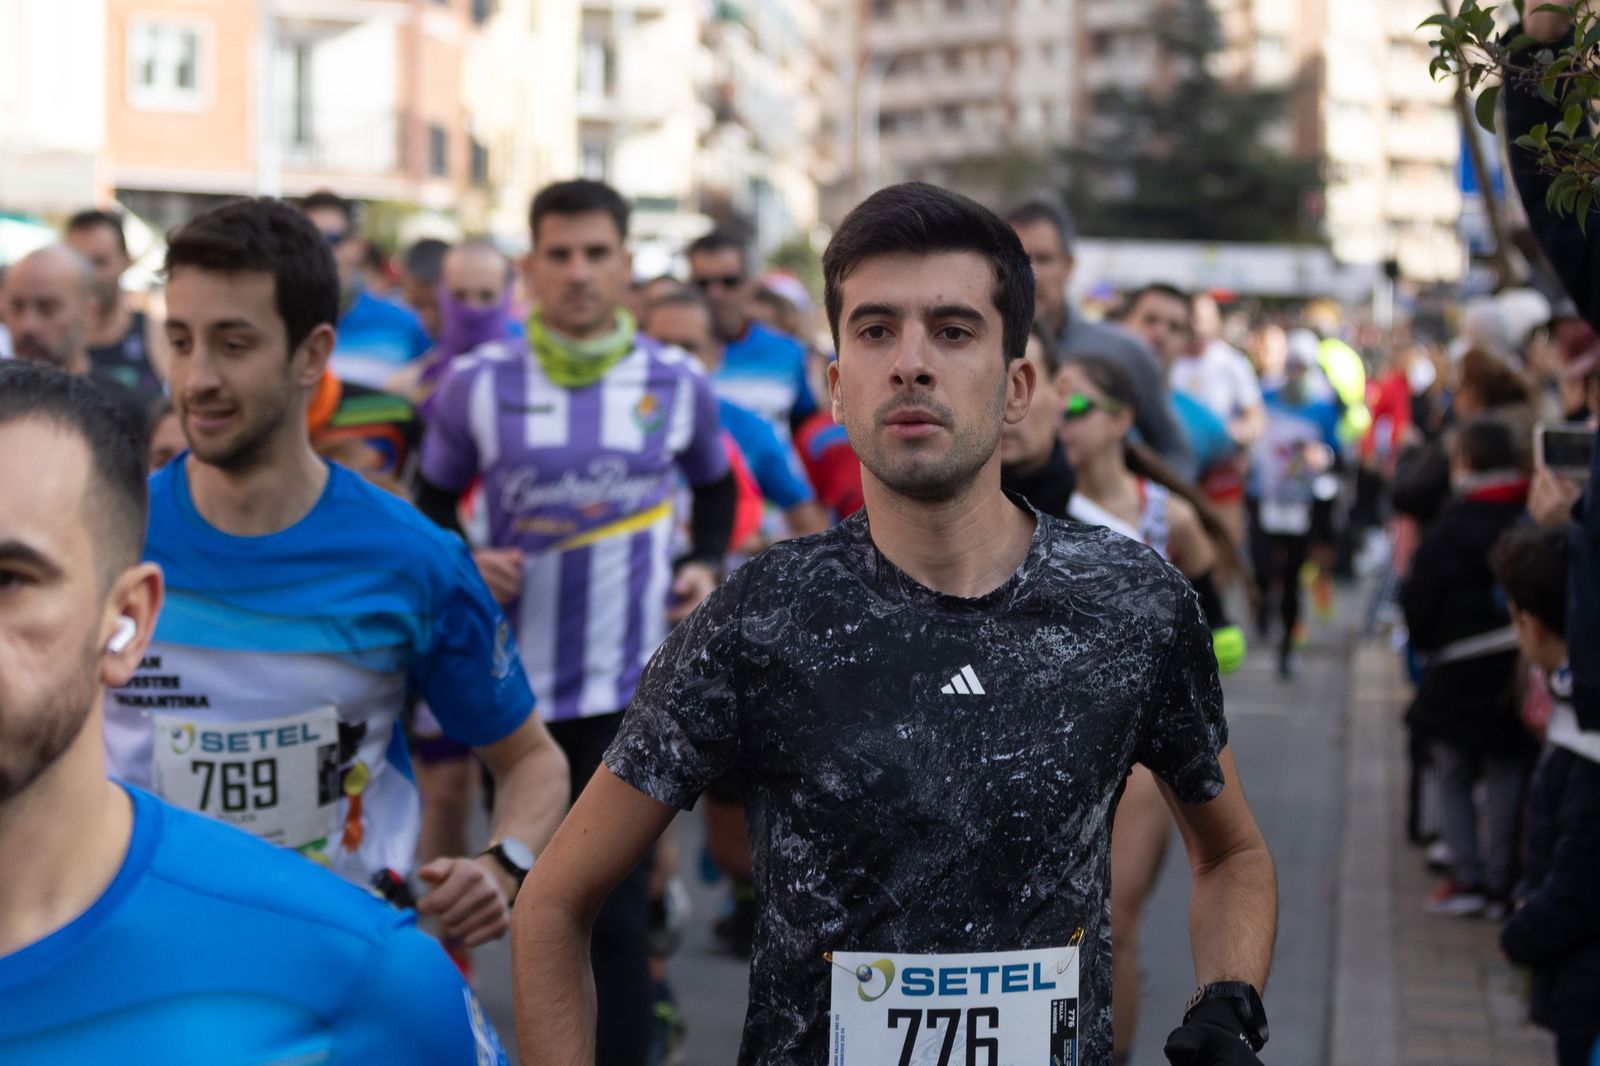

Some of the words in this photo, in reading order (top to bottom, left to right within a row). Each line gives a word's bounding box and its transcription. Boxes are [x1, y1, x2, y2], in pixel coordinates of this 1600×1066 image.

[139, 656, 161, 669] AN
[114, 694, 210, 708] ALMANTINA
[200, 724, 321, 753] SETEL
[191, 758, 278, 812] 769
[901, 962, 1056, 996] SETEL
[887, 1007, 999, 1066] 776
